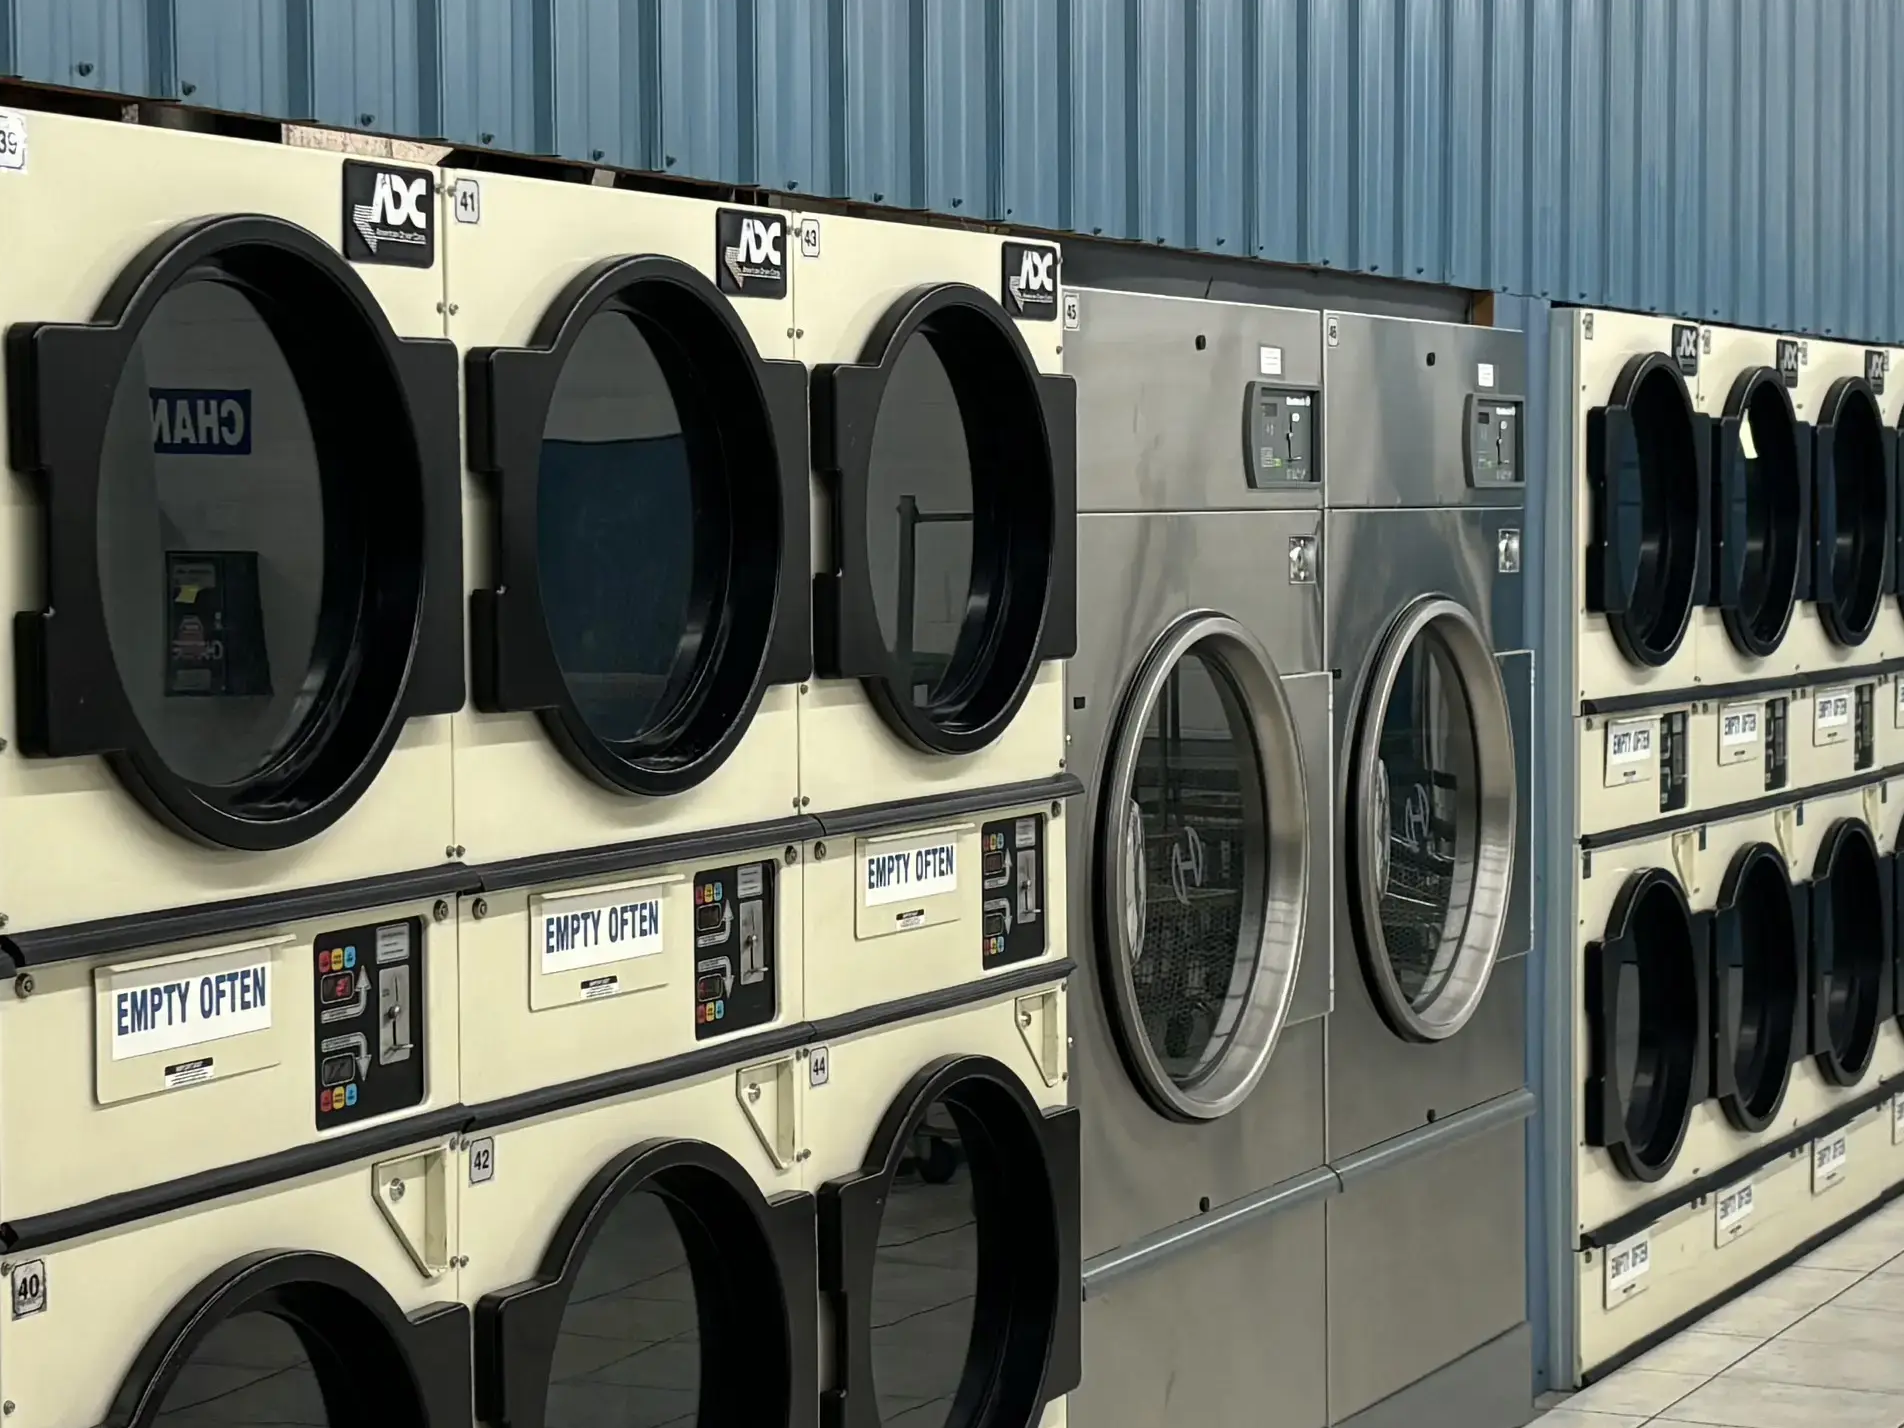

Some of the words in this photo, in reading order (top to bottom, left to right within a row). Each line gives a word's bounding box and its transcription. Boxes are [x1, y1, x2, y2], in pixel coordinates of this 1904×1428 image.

[371, 172, 427, 229] ADC
[460, 191, 475, 212] 41
[736, 218, 781, 266] ADC
[804, 229, 816, 247] 43
[1019, 250, 1053, 292] ADC
[1067, 304, 1077, 320] 45
[868, 853, 910, 889] EMPTY
[916, 845, 954, 881] OFTEN
[546, 910, 601, 953] EMPTY
[609, 900, 659, 943] OFTEN
[117, 980, 190, 1036] EMPTY
[199, 966, 266, 1020] OFTEN
[813, 1056, 825, 1076] 44
[474, 1149, 489, 1170] 42
[18, 1274, 39, 1300] 40
